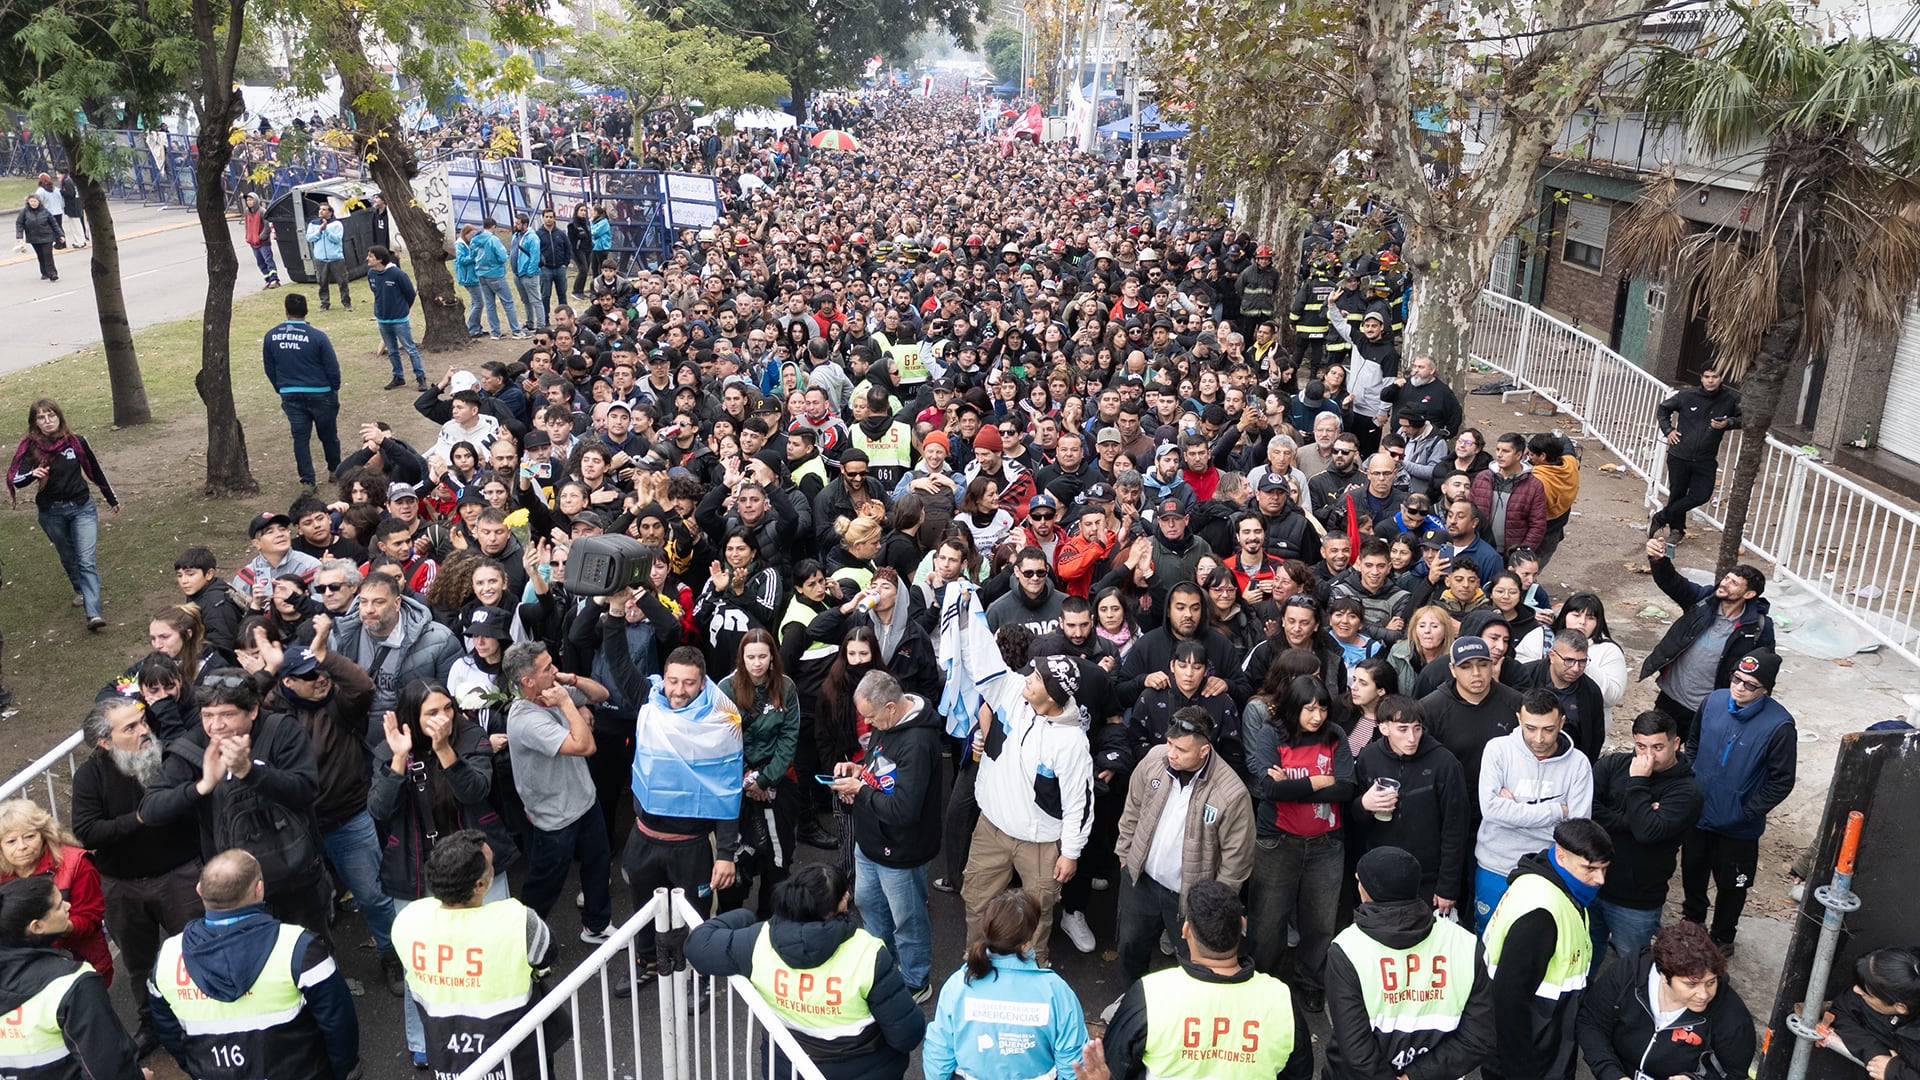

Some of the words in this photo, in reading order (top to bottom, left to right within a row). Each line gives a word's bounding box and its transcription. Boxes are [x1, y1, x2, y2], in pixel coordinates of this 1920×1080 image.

[271, 333, 310, 343] DEFENSA
[279, 342, 302, 350] CIVIL
[877, 468, 893, 481] 061
[972, 1009, 1040, 1022] EMERGENCIAS
[447, 1032, 485, 1053] 427
[211, 1044, 245, 1067] 116
